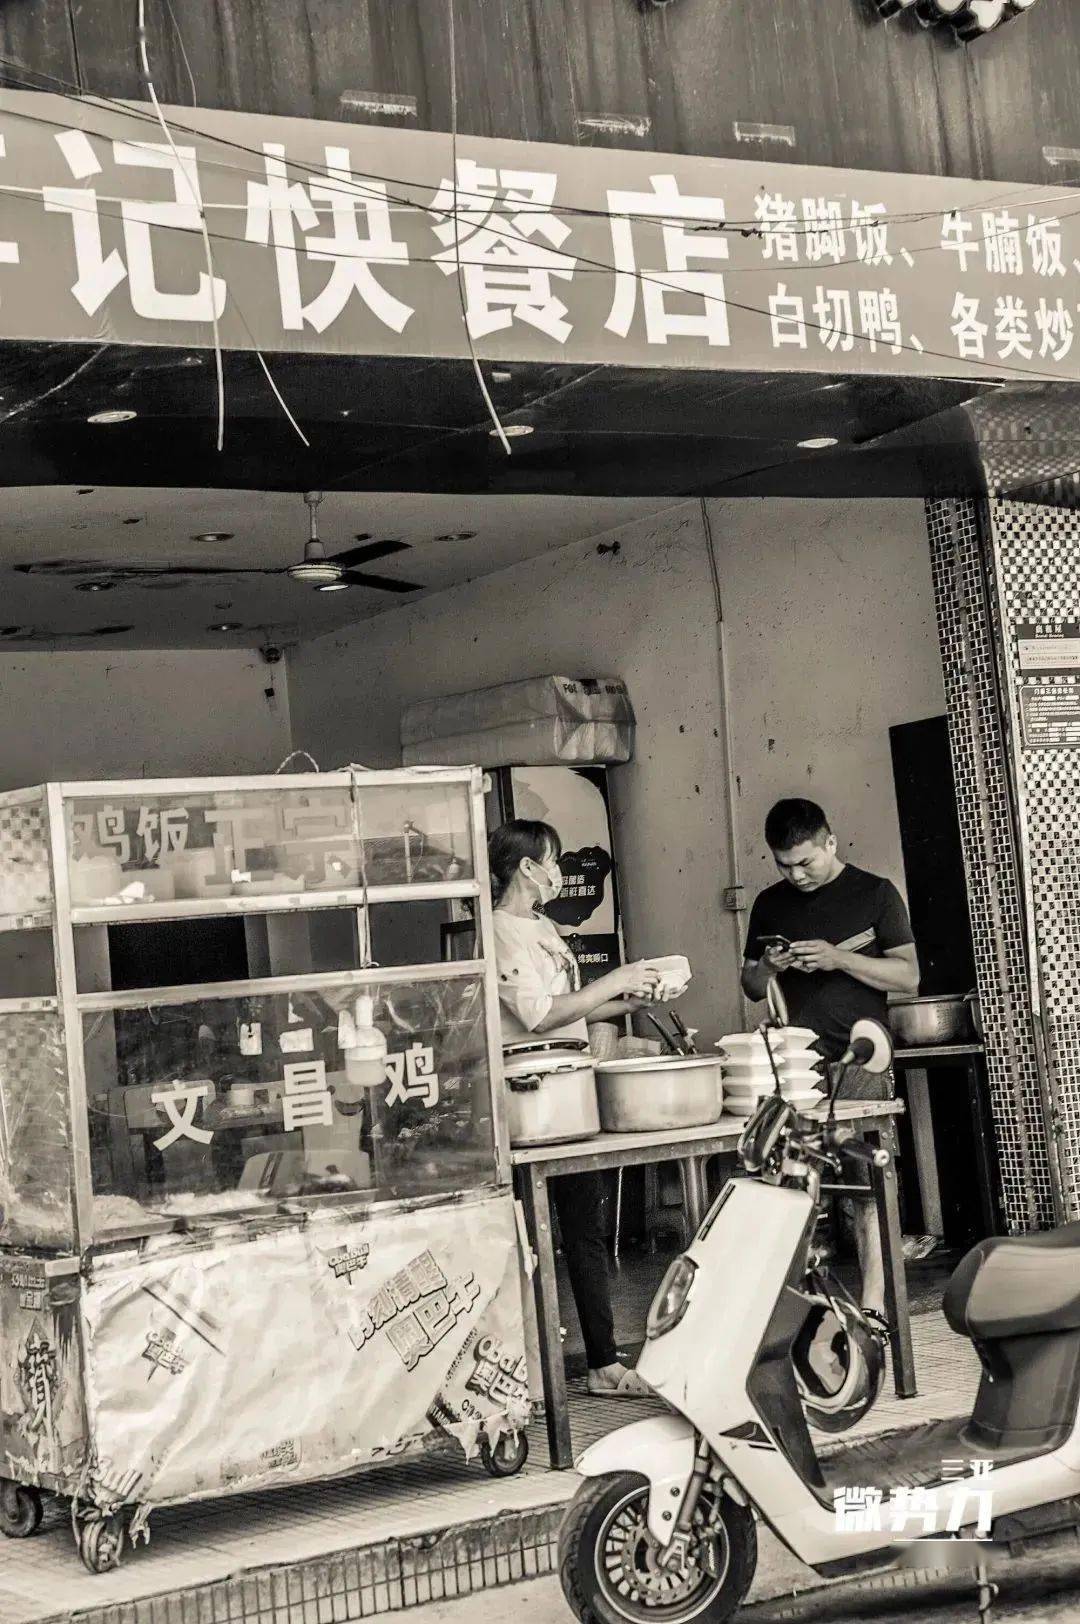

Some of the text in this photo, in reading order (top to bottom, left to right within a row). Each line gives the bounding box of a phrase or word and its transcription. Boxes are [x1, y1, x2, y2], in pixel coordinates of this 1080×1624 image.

[0, 129, 730, 347] 记快餐店
[151, 1042, 441, 1151] 文昌鸡
[386, 1271, 481, 1372] 奥巴牛
